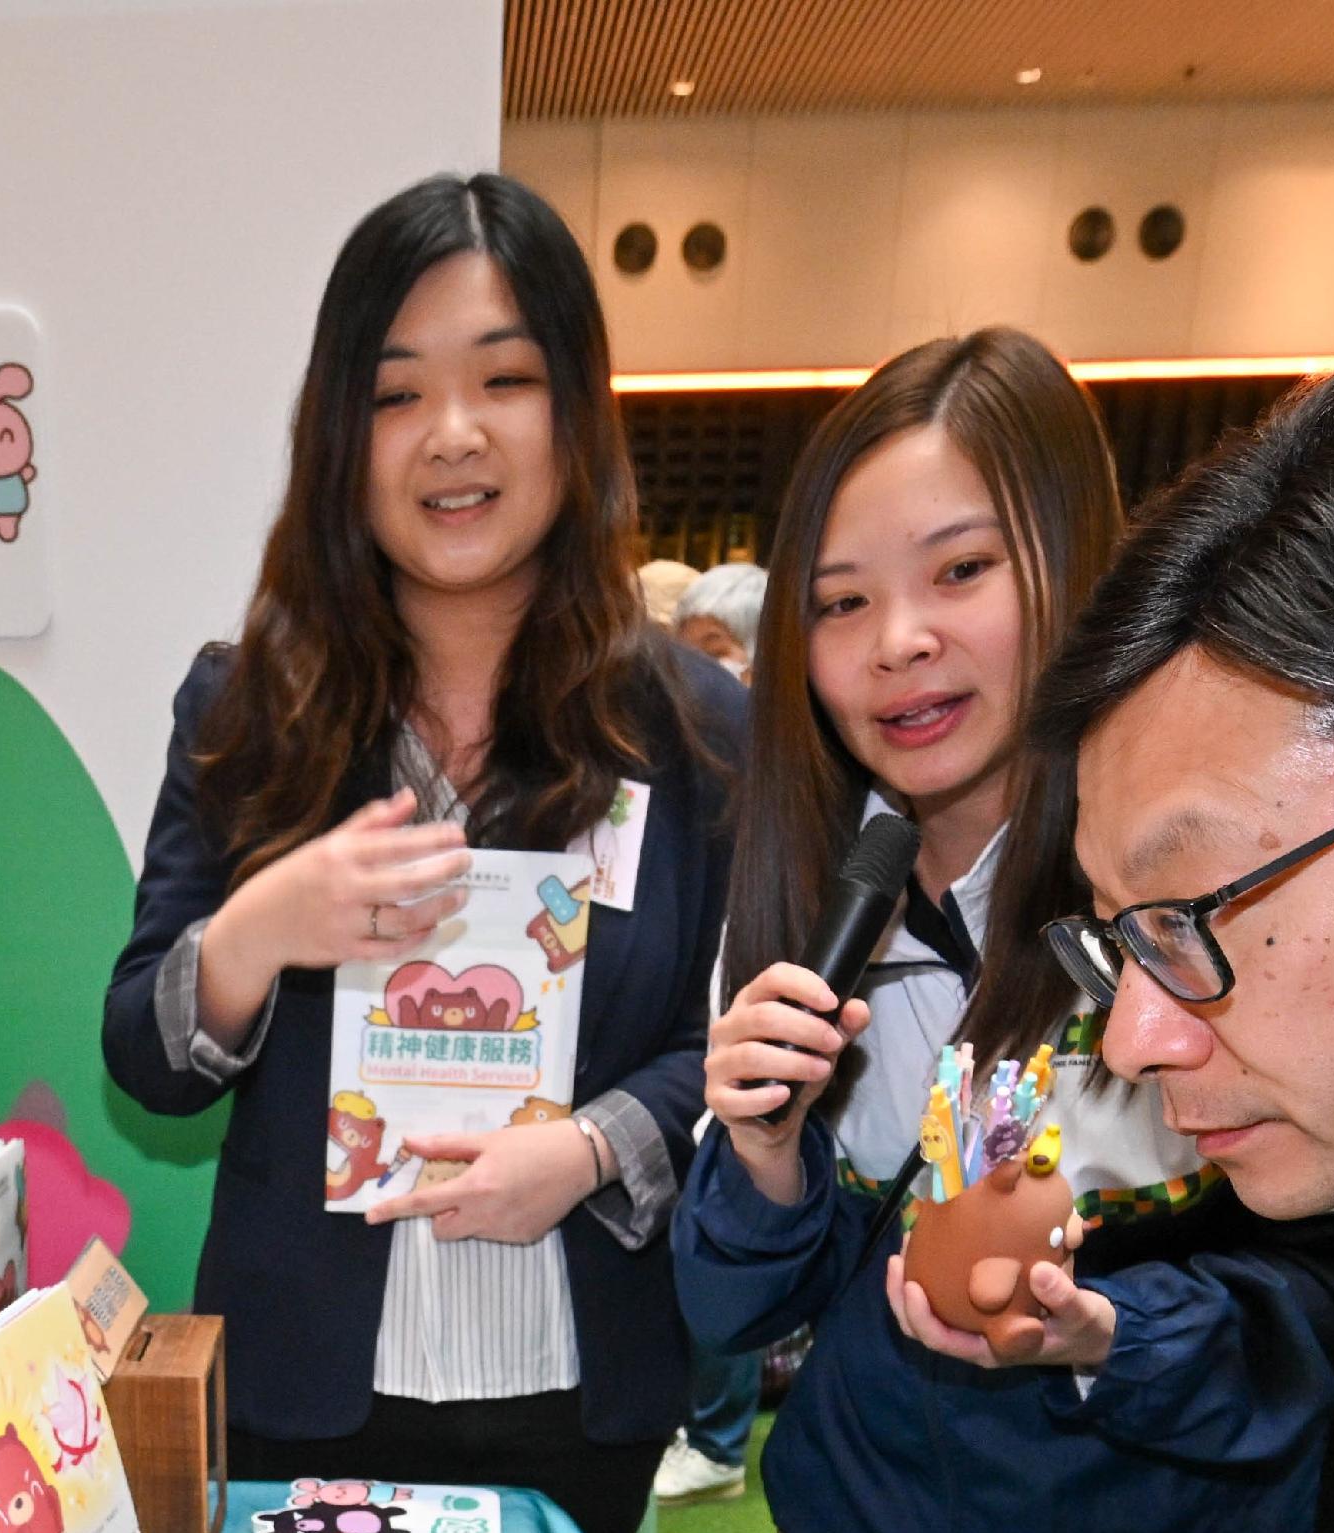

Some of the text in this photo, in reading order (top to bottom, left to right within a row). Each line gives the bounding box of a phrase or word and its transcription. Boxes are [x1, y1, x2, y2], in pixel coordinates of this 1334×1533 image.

[368, 1033, 534, 1065] 精神健康服務
[368, 1065, 533, 1084] Mental Health Services
